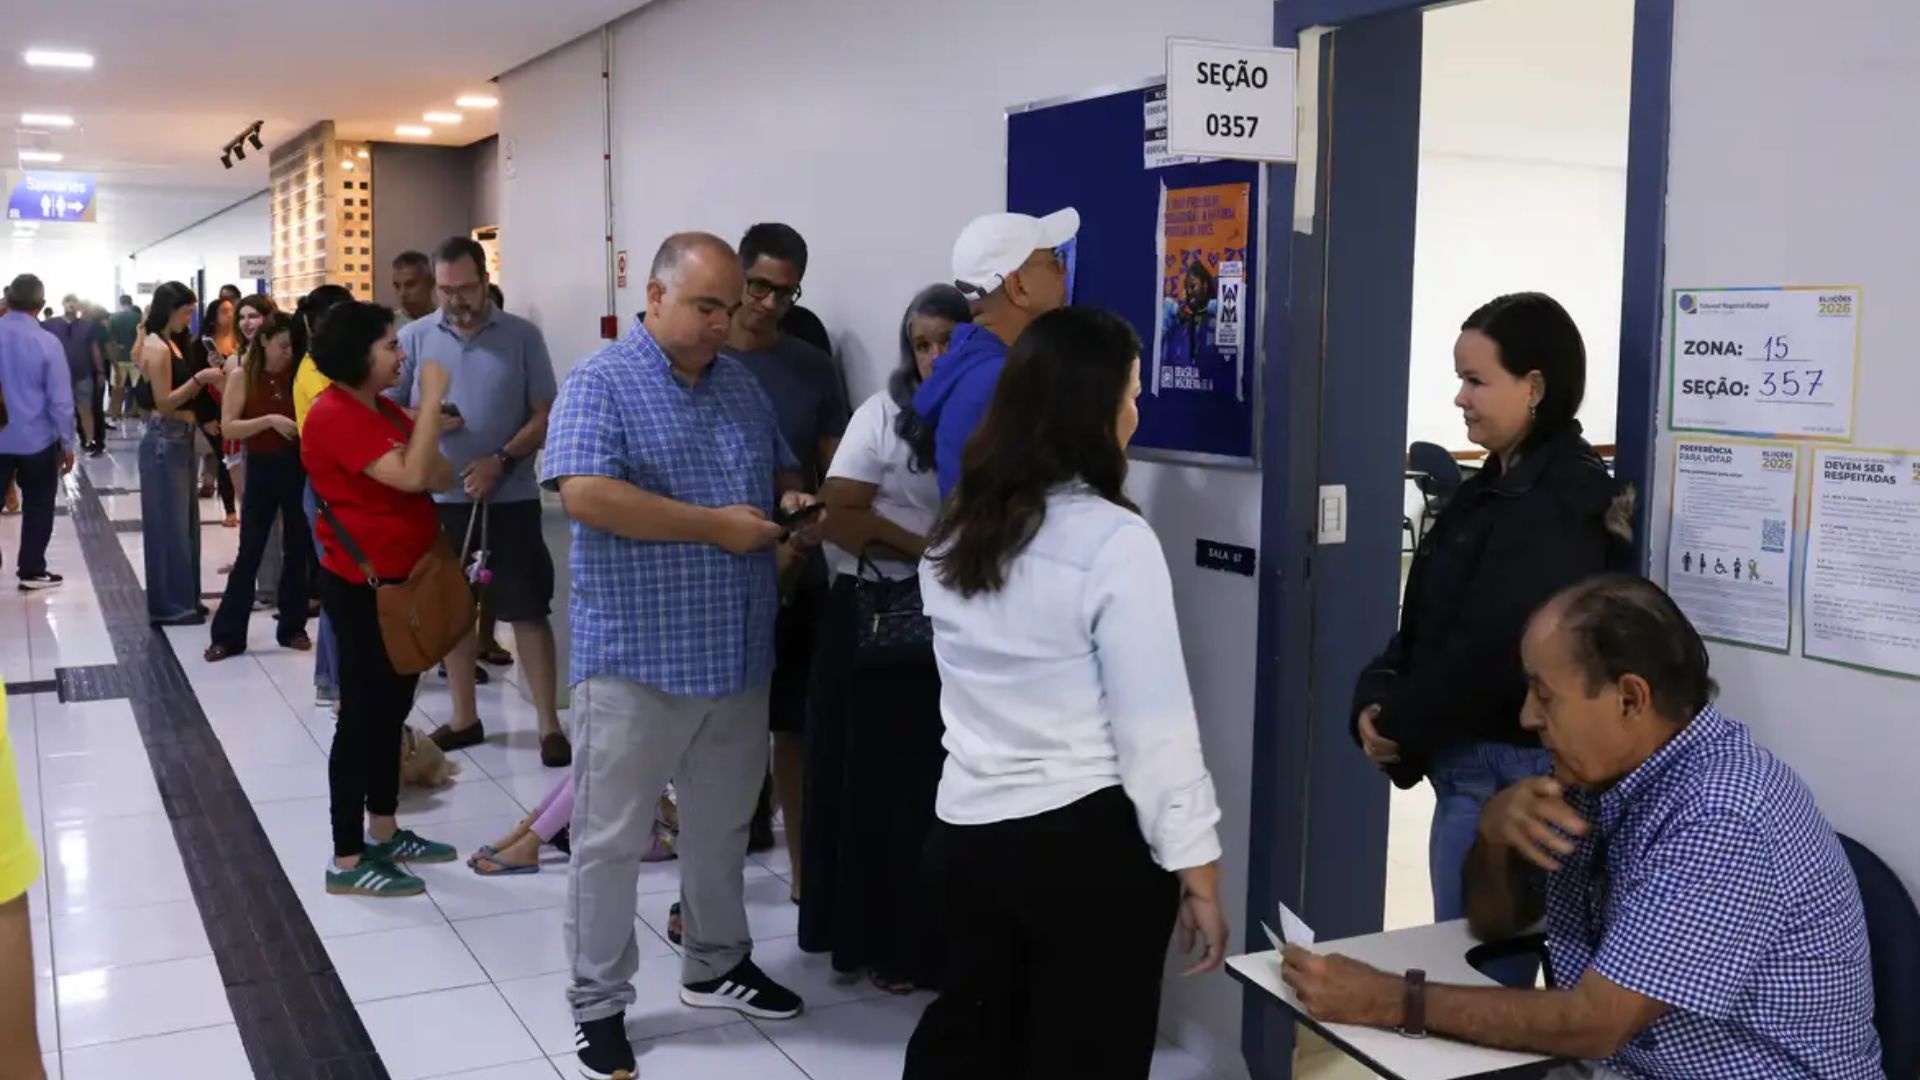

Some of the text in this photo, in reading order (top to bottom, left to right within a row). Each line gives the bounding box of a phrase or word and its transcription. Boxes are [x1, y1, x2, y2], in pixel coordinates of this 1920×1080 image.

[1197, 60, 1268, 92] SEÇÃO
[1206, 113, 1259, 139] 0357
[1819, 303, 1851, 314] 2026
[1683, 340, 1743, 357] ZONA:
[1763, 335, 1789, 361] 15
[1682, 376, 1750, 399] SEÇÃO:
[1759, 370, 1824, 397] 357
[1679, 444, 1733, 456] PREFERÊNCIA
[1679, 453, 1733, 464] PARA VOTAR
[1762, 458, 1793, 470] 2026
[1824, 461, 1885, 473] DEVEM SER
[1824, 471, 1897, 485] RESPEITADAS
[1208, 547, 1229, 561] SALA
